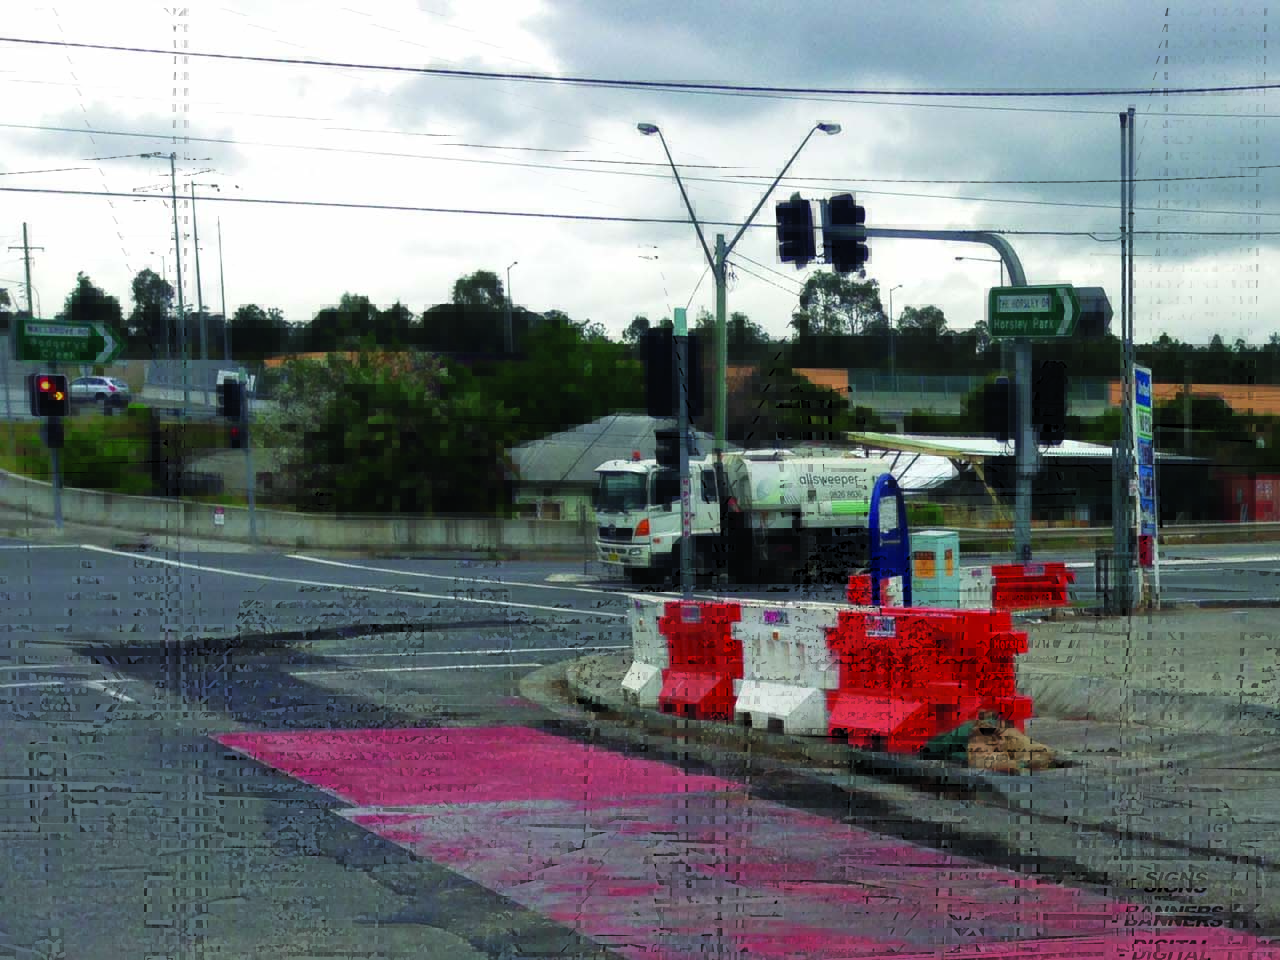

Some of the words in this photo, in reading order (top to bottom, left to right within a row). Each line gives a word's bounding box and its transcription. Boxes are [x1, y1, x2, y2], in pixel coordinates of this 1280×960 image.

[994, 318, 1027, 332] Horsley
[1033, 317, 1054, 329] Park
[800, 473, 858, 488] allsweeper
